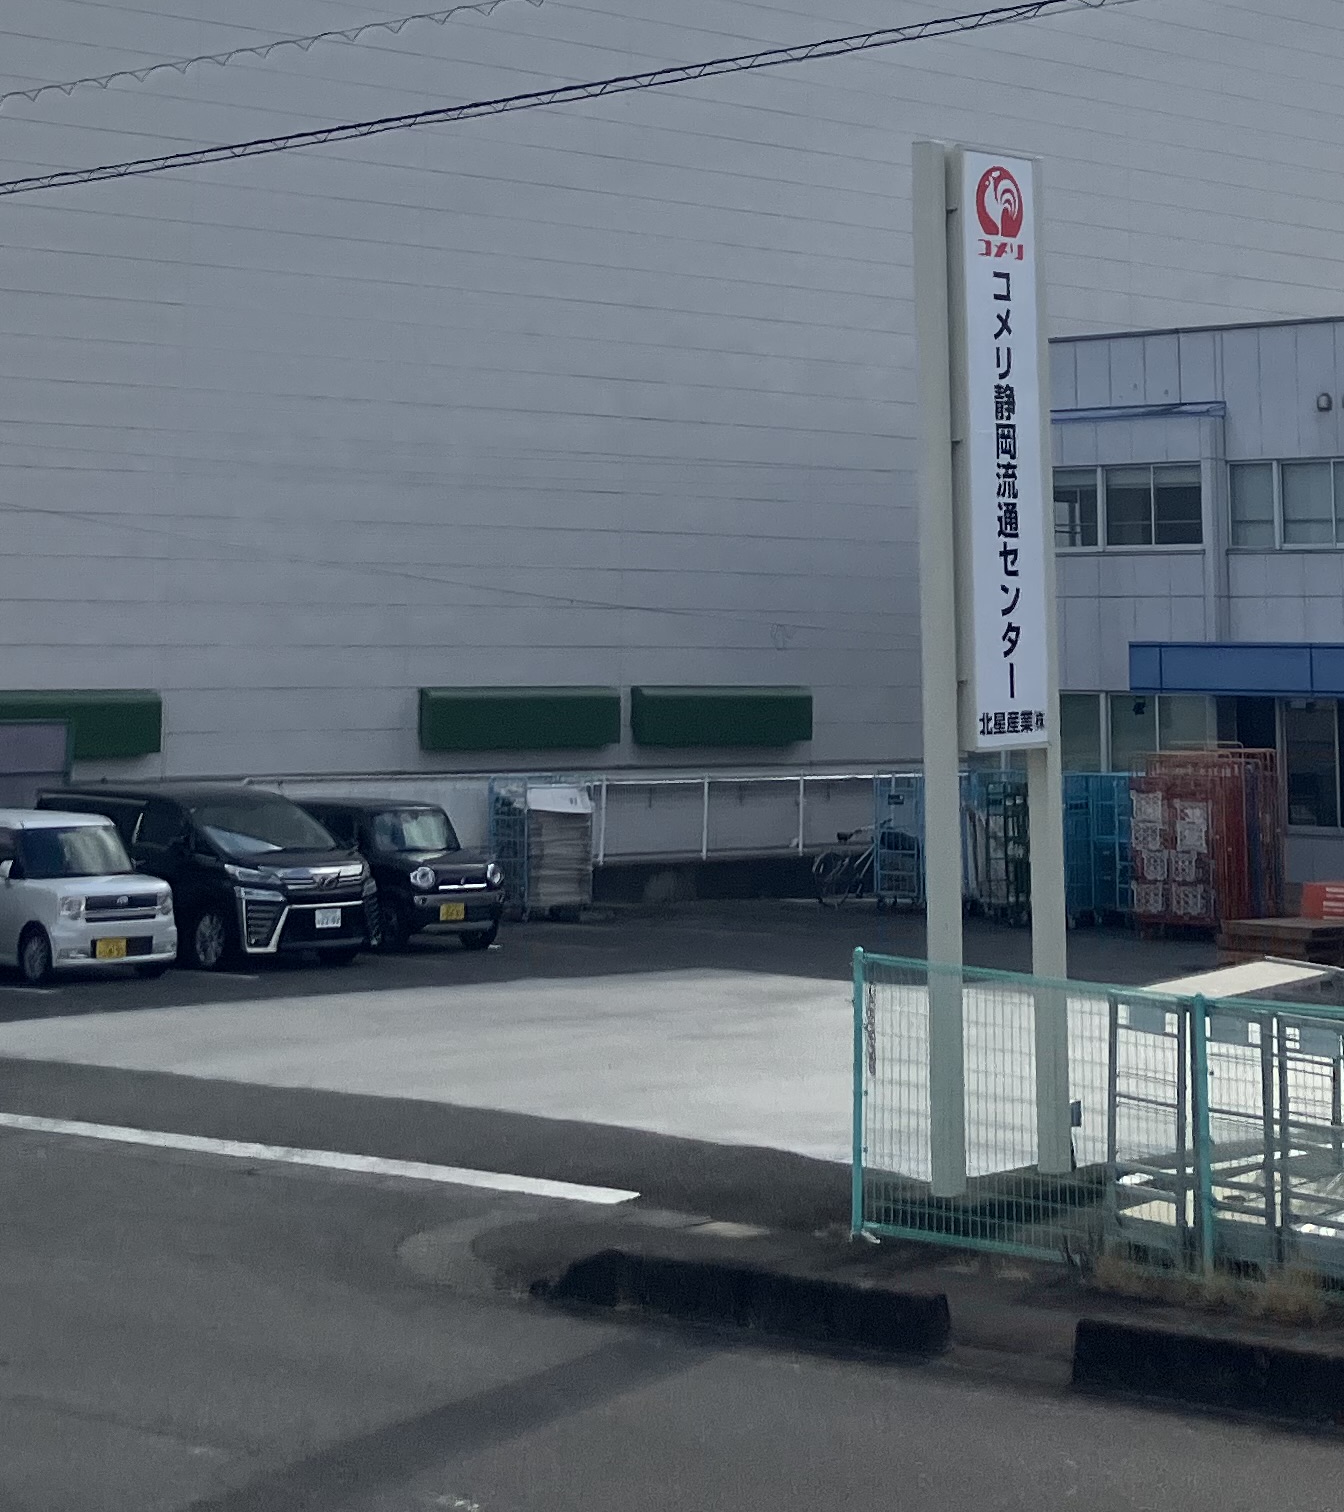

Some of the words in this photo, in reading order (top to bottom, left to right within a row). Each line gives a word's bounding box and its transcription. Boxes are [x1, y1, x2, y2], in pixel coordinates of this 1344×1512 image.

[977, 238, 1024, 261] コメリ
[992, 270, 1022, 699] コメリ静岡流通センター
